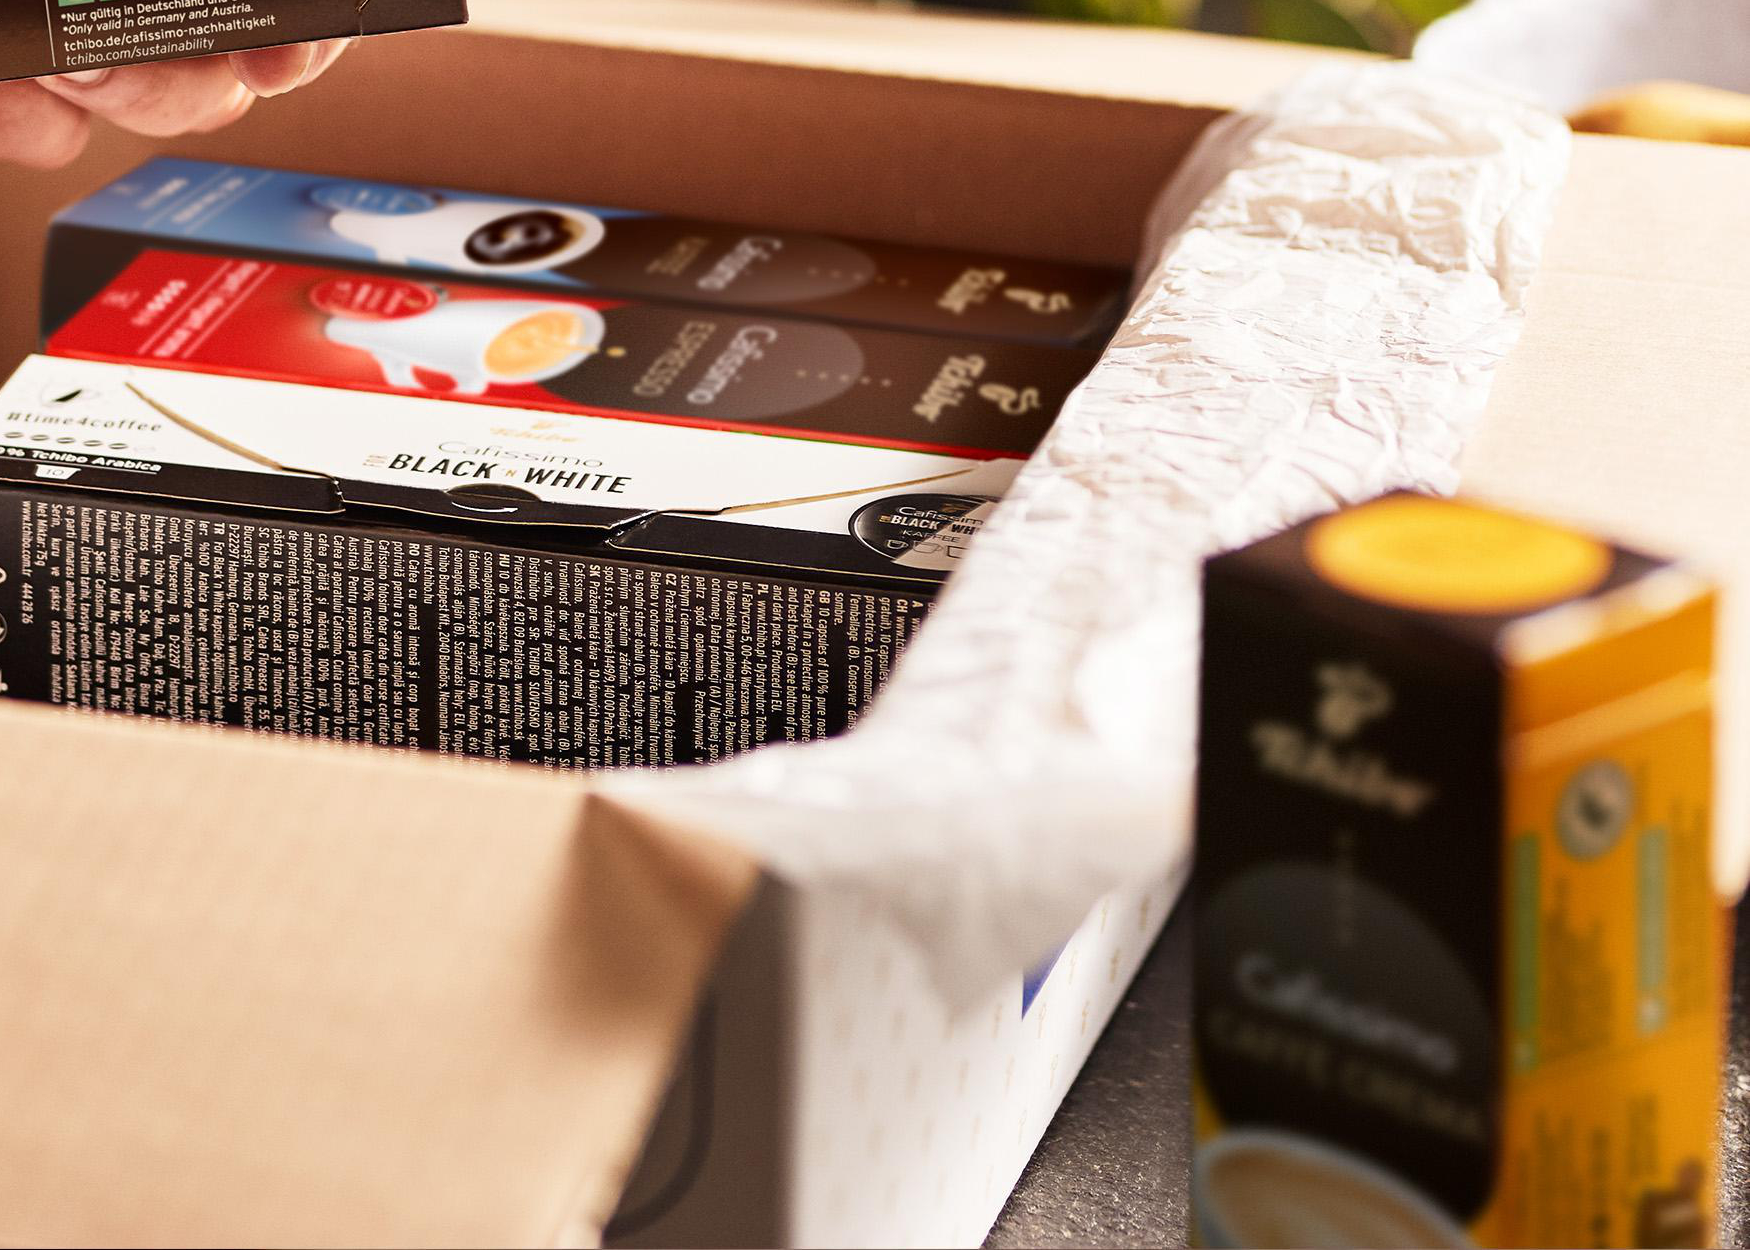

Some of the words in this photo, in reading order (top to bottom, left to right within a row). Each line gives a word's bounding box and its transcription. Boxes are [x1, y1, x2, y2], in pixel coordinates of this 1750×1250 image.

[89, 6, 121, 21] gültig
[123, 5, 134, 15] in
[96, 18, 121, 31] valid
[124, 18, 134, 27] in
[137, 12, 185, 26] Germany
[188, 7, 208, 19] and
[211, 2, 253, 16] Austria.
[64, 15, 275, 51] tchibo.de/cafissimo-nachhaltigkeit
[66, 37, 214, 66] tchibo.com/sustainability
[6, 411, 163, 432] #time4coffee
[32, 450, 88, 465] Tchibo
[91, 456, 163, 473] Arabica
[438, 440, 603, 468] Cafissimo
[388, 453, 500, 479] BLACK
[524, 467, 633, 494] WHITE
[36, 502, 48, 517] Net
[898, 506, 985, 526] Cafissim
[890, 514, 941, 530] BLACK
[21, 500, 33, 576] www.tchibo.com.tr
[36, 519, 48, 548] Miktar:
[228, 523, 240, 558] D-22297
[902, 529, 961, 543] KAFFEE
[36, 550, 48, 559] 75
[225, 561, 239, 599] Hamburg,
[423, 544, 435, 604] www.tchibo.hu
[21, 582, 33, 599] 444
[772, 584, 784, 601] and
[819, 590, 831, 603] GB
[21, 600, 33, 611] 28
[772, 602, 784, 621] dark
[818, 607, 831, 616] 10
[21, 613, 33, 623] 26
[228, 602, 240, 643] Germania.
[769, 622, 783, 647] place.
[815, 619, 830, 654] capsules
[771, 649, 783, 688] Produced
[817, 657, 829, 667] of
[228, 645, 240, 702] www.tchibo.ro
[816, 669, 829, 694] 100%
[771, 689, 783, 697] in
[770, 699, 783, 712] EU.
[814, 697, 825, 715] pure
